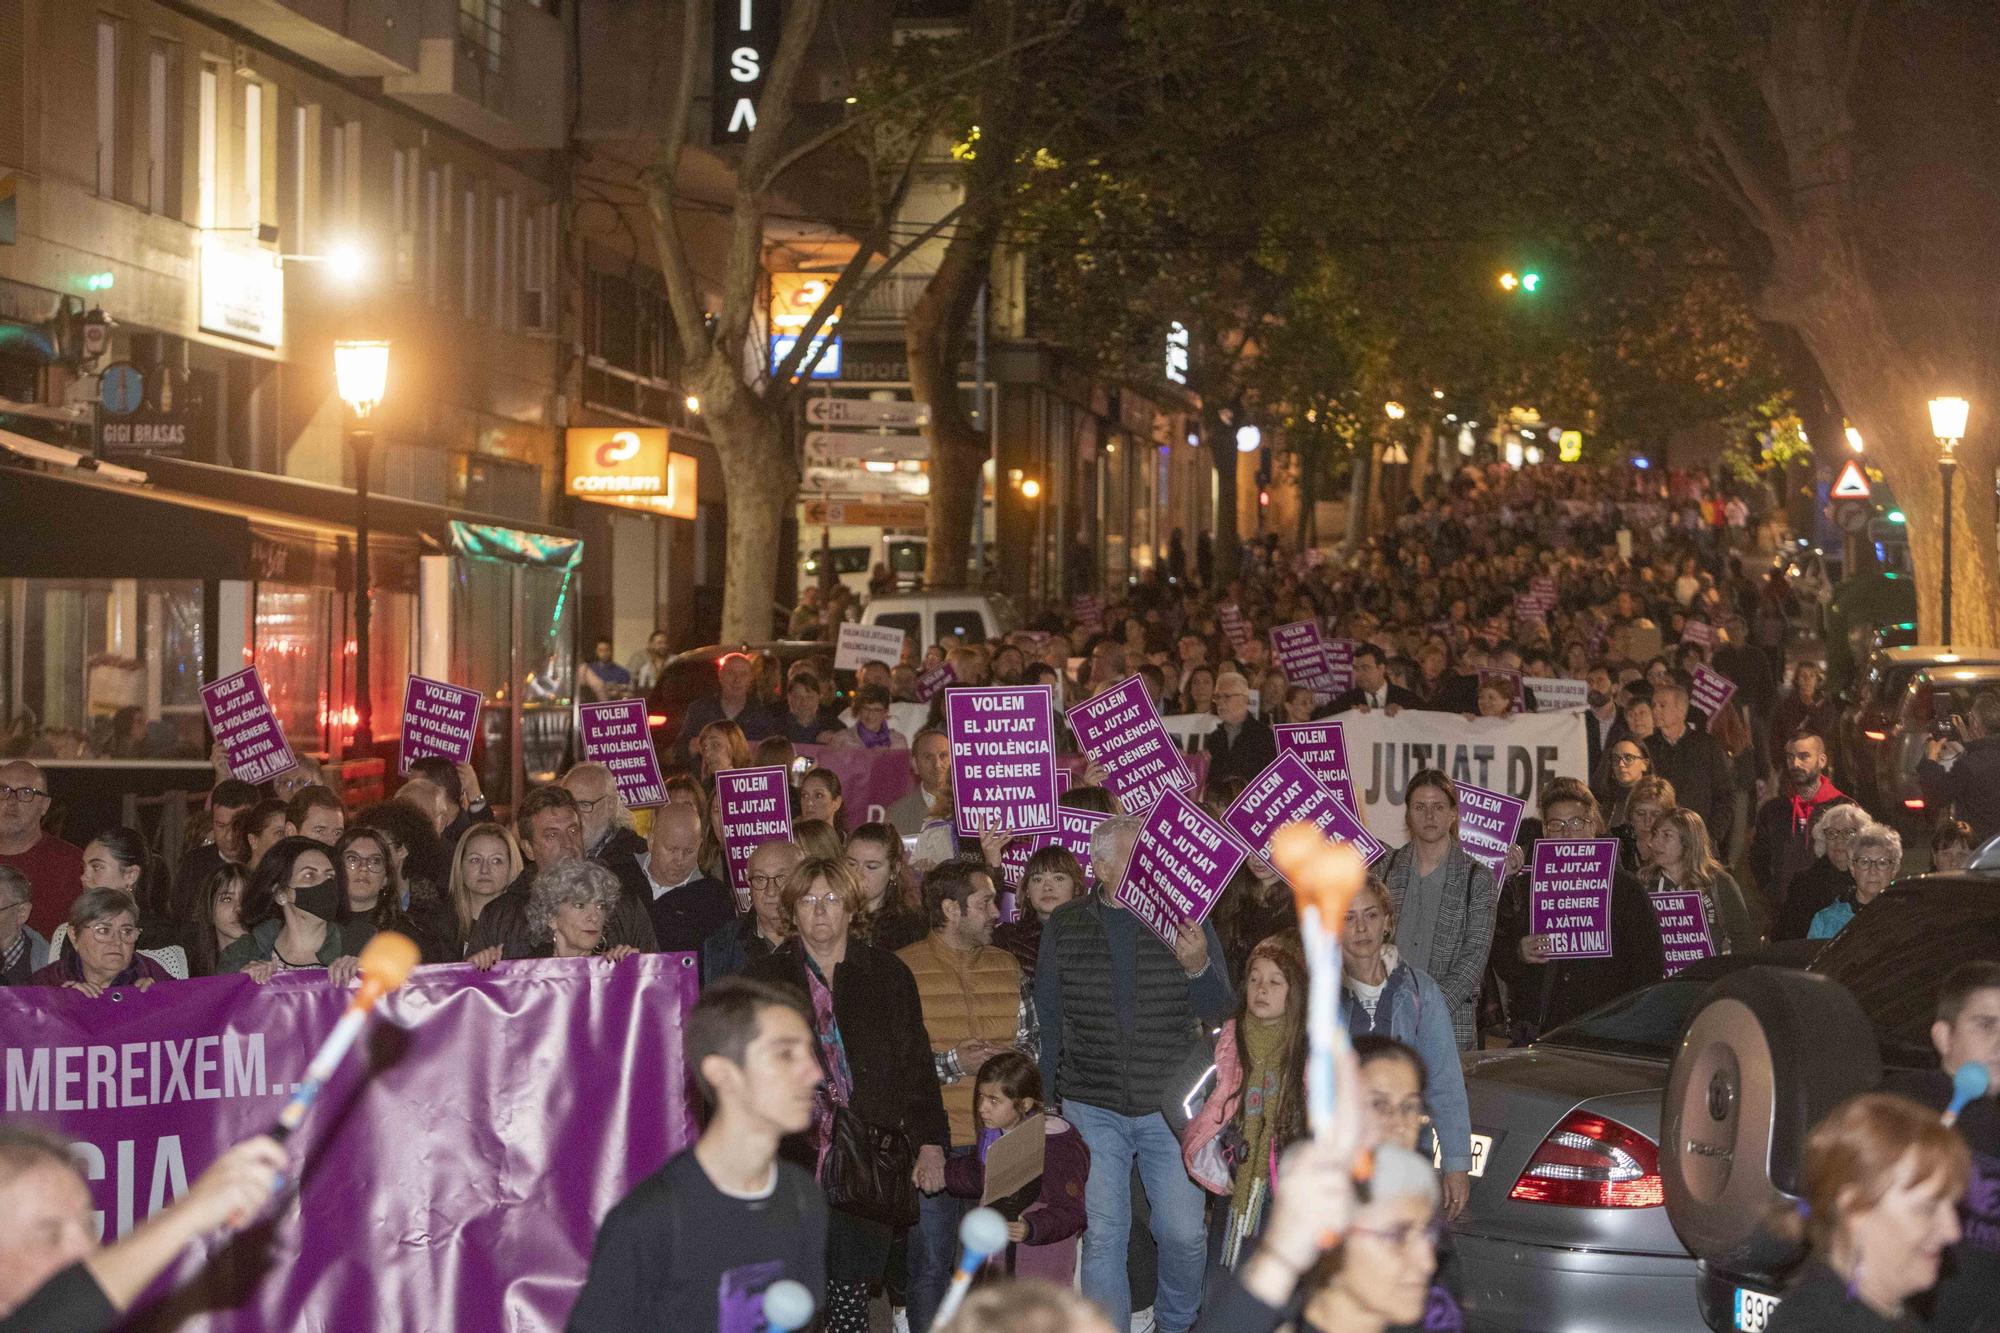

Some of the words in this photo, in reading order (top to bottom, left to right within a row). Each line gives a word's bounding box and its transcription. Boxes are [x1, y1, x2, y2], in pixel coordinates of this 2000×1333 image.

[103, 423, 131, 442] GIGI
[133, 423, 185, 443] BRASAS
[214, 677, 245, 698] VOLEM
[425, 685, 462, 705] VOLEM
[215, 704, 225, 716] EL
[226, 690, 255, 712] JUTJAT
[415, 699, 427, 711] EL
[429, 703, 466, 721] JUTJAT
[972, 696, 1024, 711] VOLEM
[1087, 690, 1128, 719] VOLEM
[595, 707, 629, 721] VOLEM
[1088, 726, 1102, 740] EL
[1104, 704, 1141, 732] JUTJAT
[213, 722, 225, 736] DE
[405, 712, 418, 725] DE
[420, 717, 470, 740] VIOLÈNCIA
[592, 727, 603, 738] EL
[605, 724, 637, 736] JUTJAT
[964, 720, 981, 733] EL
[984, 718, 1035, 732] JUTJAT
[223, 736, 236, 749] DE
[410, 730, 422, 741] DE
[424, 735, 461, 754] GÈNERE
[1087, 746, 1103, 761] DE
[1102, 718, 1160, 753] VIOLÈNCIA
[1291, 730, 1327, 745] VOLEM
[235, 752, 243, 762] A
[241, 739, 274, 759] XÀTIVA
[413, 747, 419, 757] A
[587, 744, 599, 755] DE
[600, 739, 650, 754] VIOLÈNCIA
[954, 743, 972, 756] DE
[975, 739, 1050, 755] VIOLÈNCIA
[1104, 760, 1118, 773] DE
[1119, 738, 1162, 766] GÈNERE
[233, 761, 262, 781] TOTES
[260, 756, 270, 774] A
[266, 748, 290, 771] UNA!
[609, 757, 647, 770] GÈNERE
[1301, 750, 1336, 763] JUTJAT
[964, 765, 982, 778] DE
[986, 762, 1041, 777] GÈNERE
[1117, 778, 1126, 790] A
[1125, 758, 1166, 784] XÀTIVA
[1313, 768, 1348, 783] ÈNCIA
[615, 774, 647, 785] ÀTIVA
[732, 777, 768, 793] VOLEM
[629, 788, 638, 803] A
[637, 785, 661, 801] UNA!
[973, 788, 982, 801] A
[985, 785, 1035, 800] XÀTIVA
[1118, 785, 1151, 813] OTES
[1148, 780, 1160, 800] A
[1241, 771, 1284, 814] VOLEM
[728, 801, 739, 814] EL
[741, 799, 776, 814] JUTJAT
[1250, 820, 1267, 837] EL
[1266, 780, 1303, 823] JUTJAT
[1460, 790, 1502, 813] VOLEM
[963, 806, 1002, 830] TOTES
[1006, 806, 1016, 829] A
[1018, 803, 1051, 828] UNA!
[1462, 812, 1505, 832] JUTJAT
[724, 824, 734, 837] DE
[736, 819, 788, 837] VIOLÈNCIA
[1063, 817, 1100, 834] VOLE
[1177, 806, 1223, 852] VOLEM
[732, 847, 741, 860] DE
[1157, 819, 1172, 839] EL
[1173, 835, 1218, 875] JUTJAT
[1555, 845, 1596, 857] VOLEM
[1140, 829, 1157, 850] DE
[1156, 844, 1213, 902] VIOLÈNCIA
[1545, 863, 1558, 873] EL
[1560, 862, 1601, 873] JUTJAT
[738, 869, 743, 881] A
[1139, 876, 1146, 889] A
[1139, 853, 1154, 874] DE
[1153, 869, 1195, 915] GÈNERE
[1535, 881, 1549, 892] DE
[1551, 877, 1609, 891] VIOLÈNCIA
[1124, 879, 1156, 922] TOTES
[1154, 912, 1163, 931] A
[1541, 899, 1555, 910] DE
[1557, 897, 1600, 909] GÈNERE
[1653, 899, 1685, 911] OLEM
[1546, 918, 1553, 929] A
[1556, 914, 1594, 928] XÀTIVA
[1659, 916, 1694, 927] JUTJAT
[1550, 932, 1568, 953] TES
[1571, 932, 1579, 952] A
[1580, 931, 1605, 951] UNA!
[1662, 930, 1708, 945] IOLÈNCIA
[1665, 948, 1704, 961] GÈNERE
